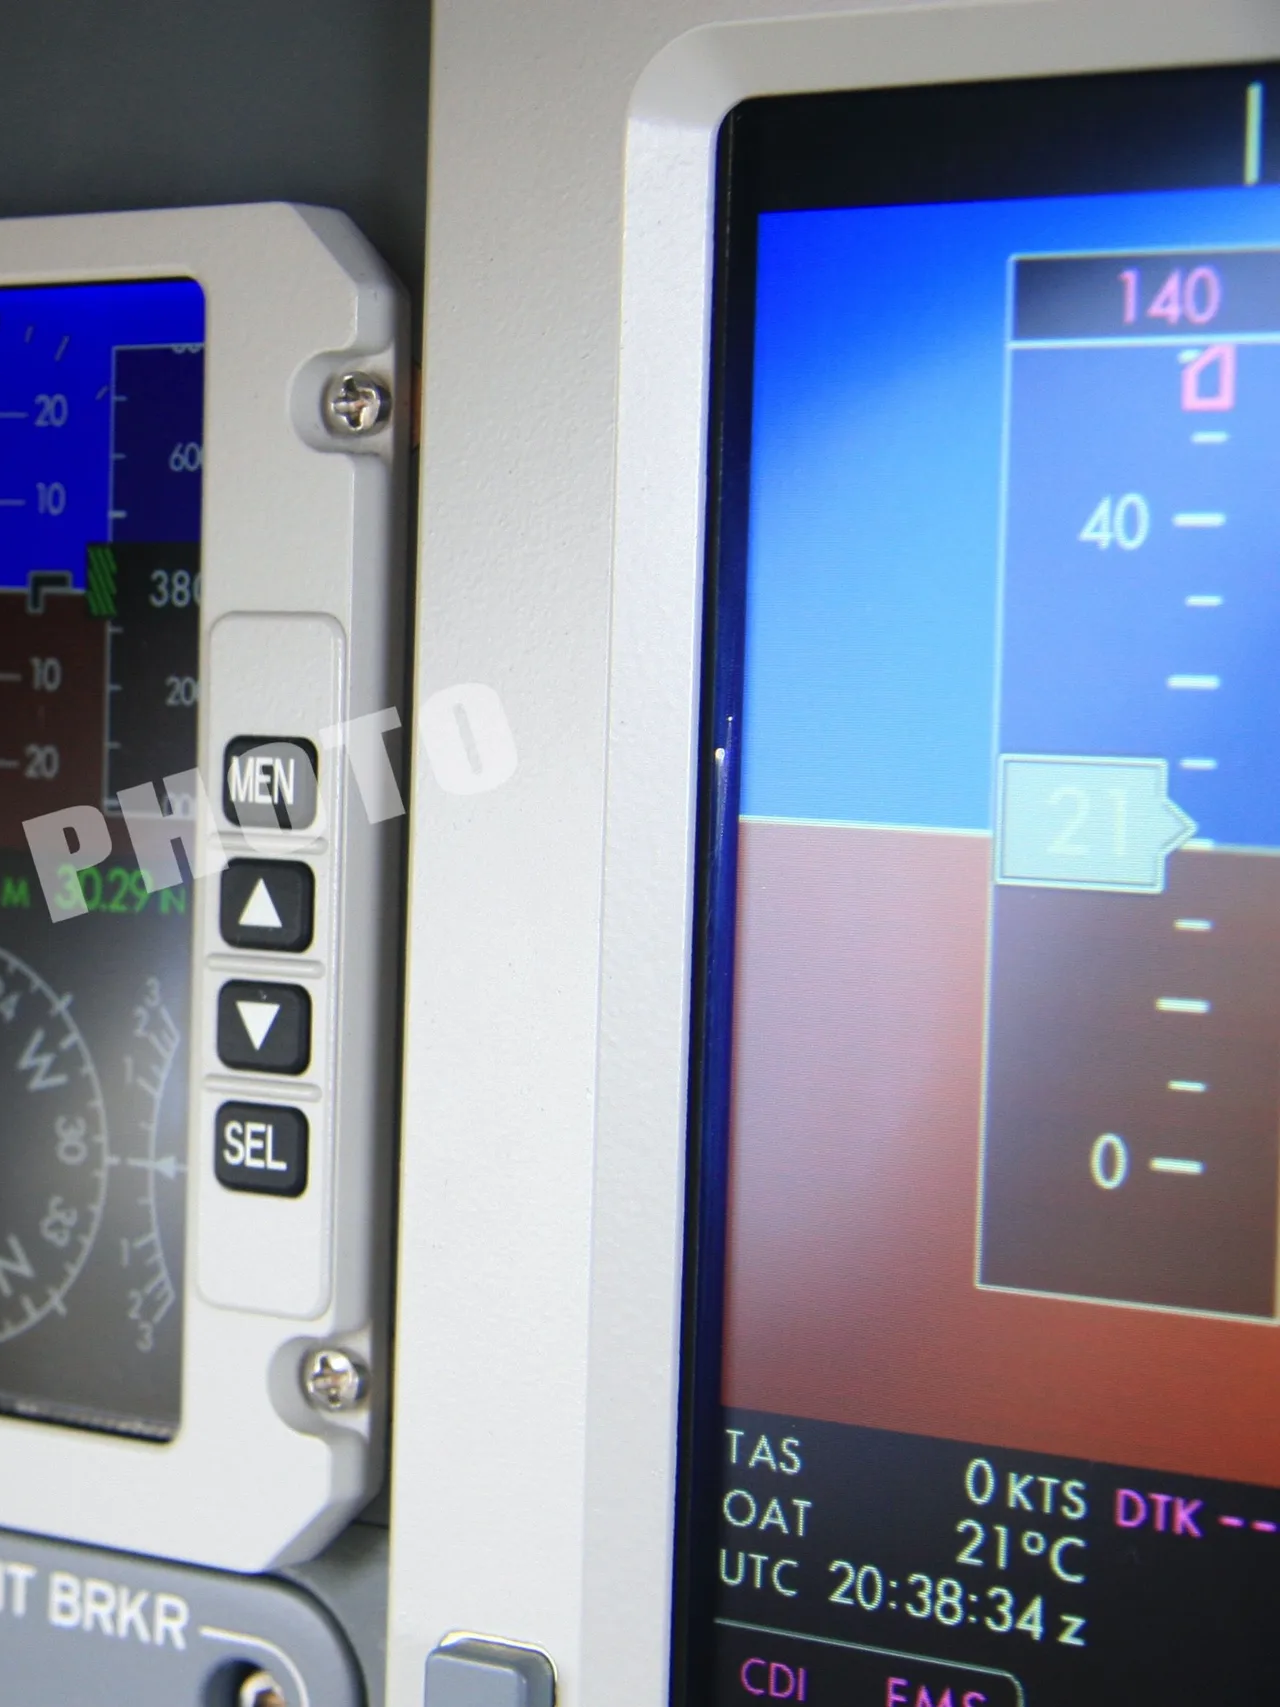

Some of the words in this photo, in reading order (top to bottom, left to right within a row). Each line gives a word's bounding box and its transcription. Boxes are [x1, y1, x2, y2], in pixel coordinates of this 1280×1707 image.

[1117, 266, 1222, 325] 140
[35, 394, 68, 427] 20
[36, 482, 67, 515] 10
[1079, 493, 1150, 549] 40
[31, 658, 61, 693] 10
[26, 745, 59, 779] 20
[230, 756, 295, 805] MEN
[1047, 786, 1129, 857] 21
[223, 1121, 287, 1172] SEL
[1090, 1133, 1128, 1190] 0
[725, 1429, 802, 1475] TAS
[964, 1458, 995, 1505] 0
[1007, 1472, 1086, 1521] KTS
[722, 1489, 812, 1536] OAT
[1114, 1489, 1203, 1538] DTK
[48, 1572, 190, 1651] BRKR
[720, 1549, 798, 1597] UTC
[828, 1560, 1045, 1641] 20:38:34
[740, 1657, 807, 1701] CDI
